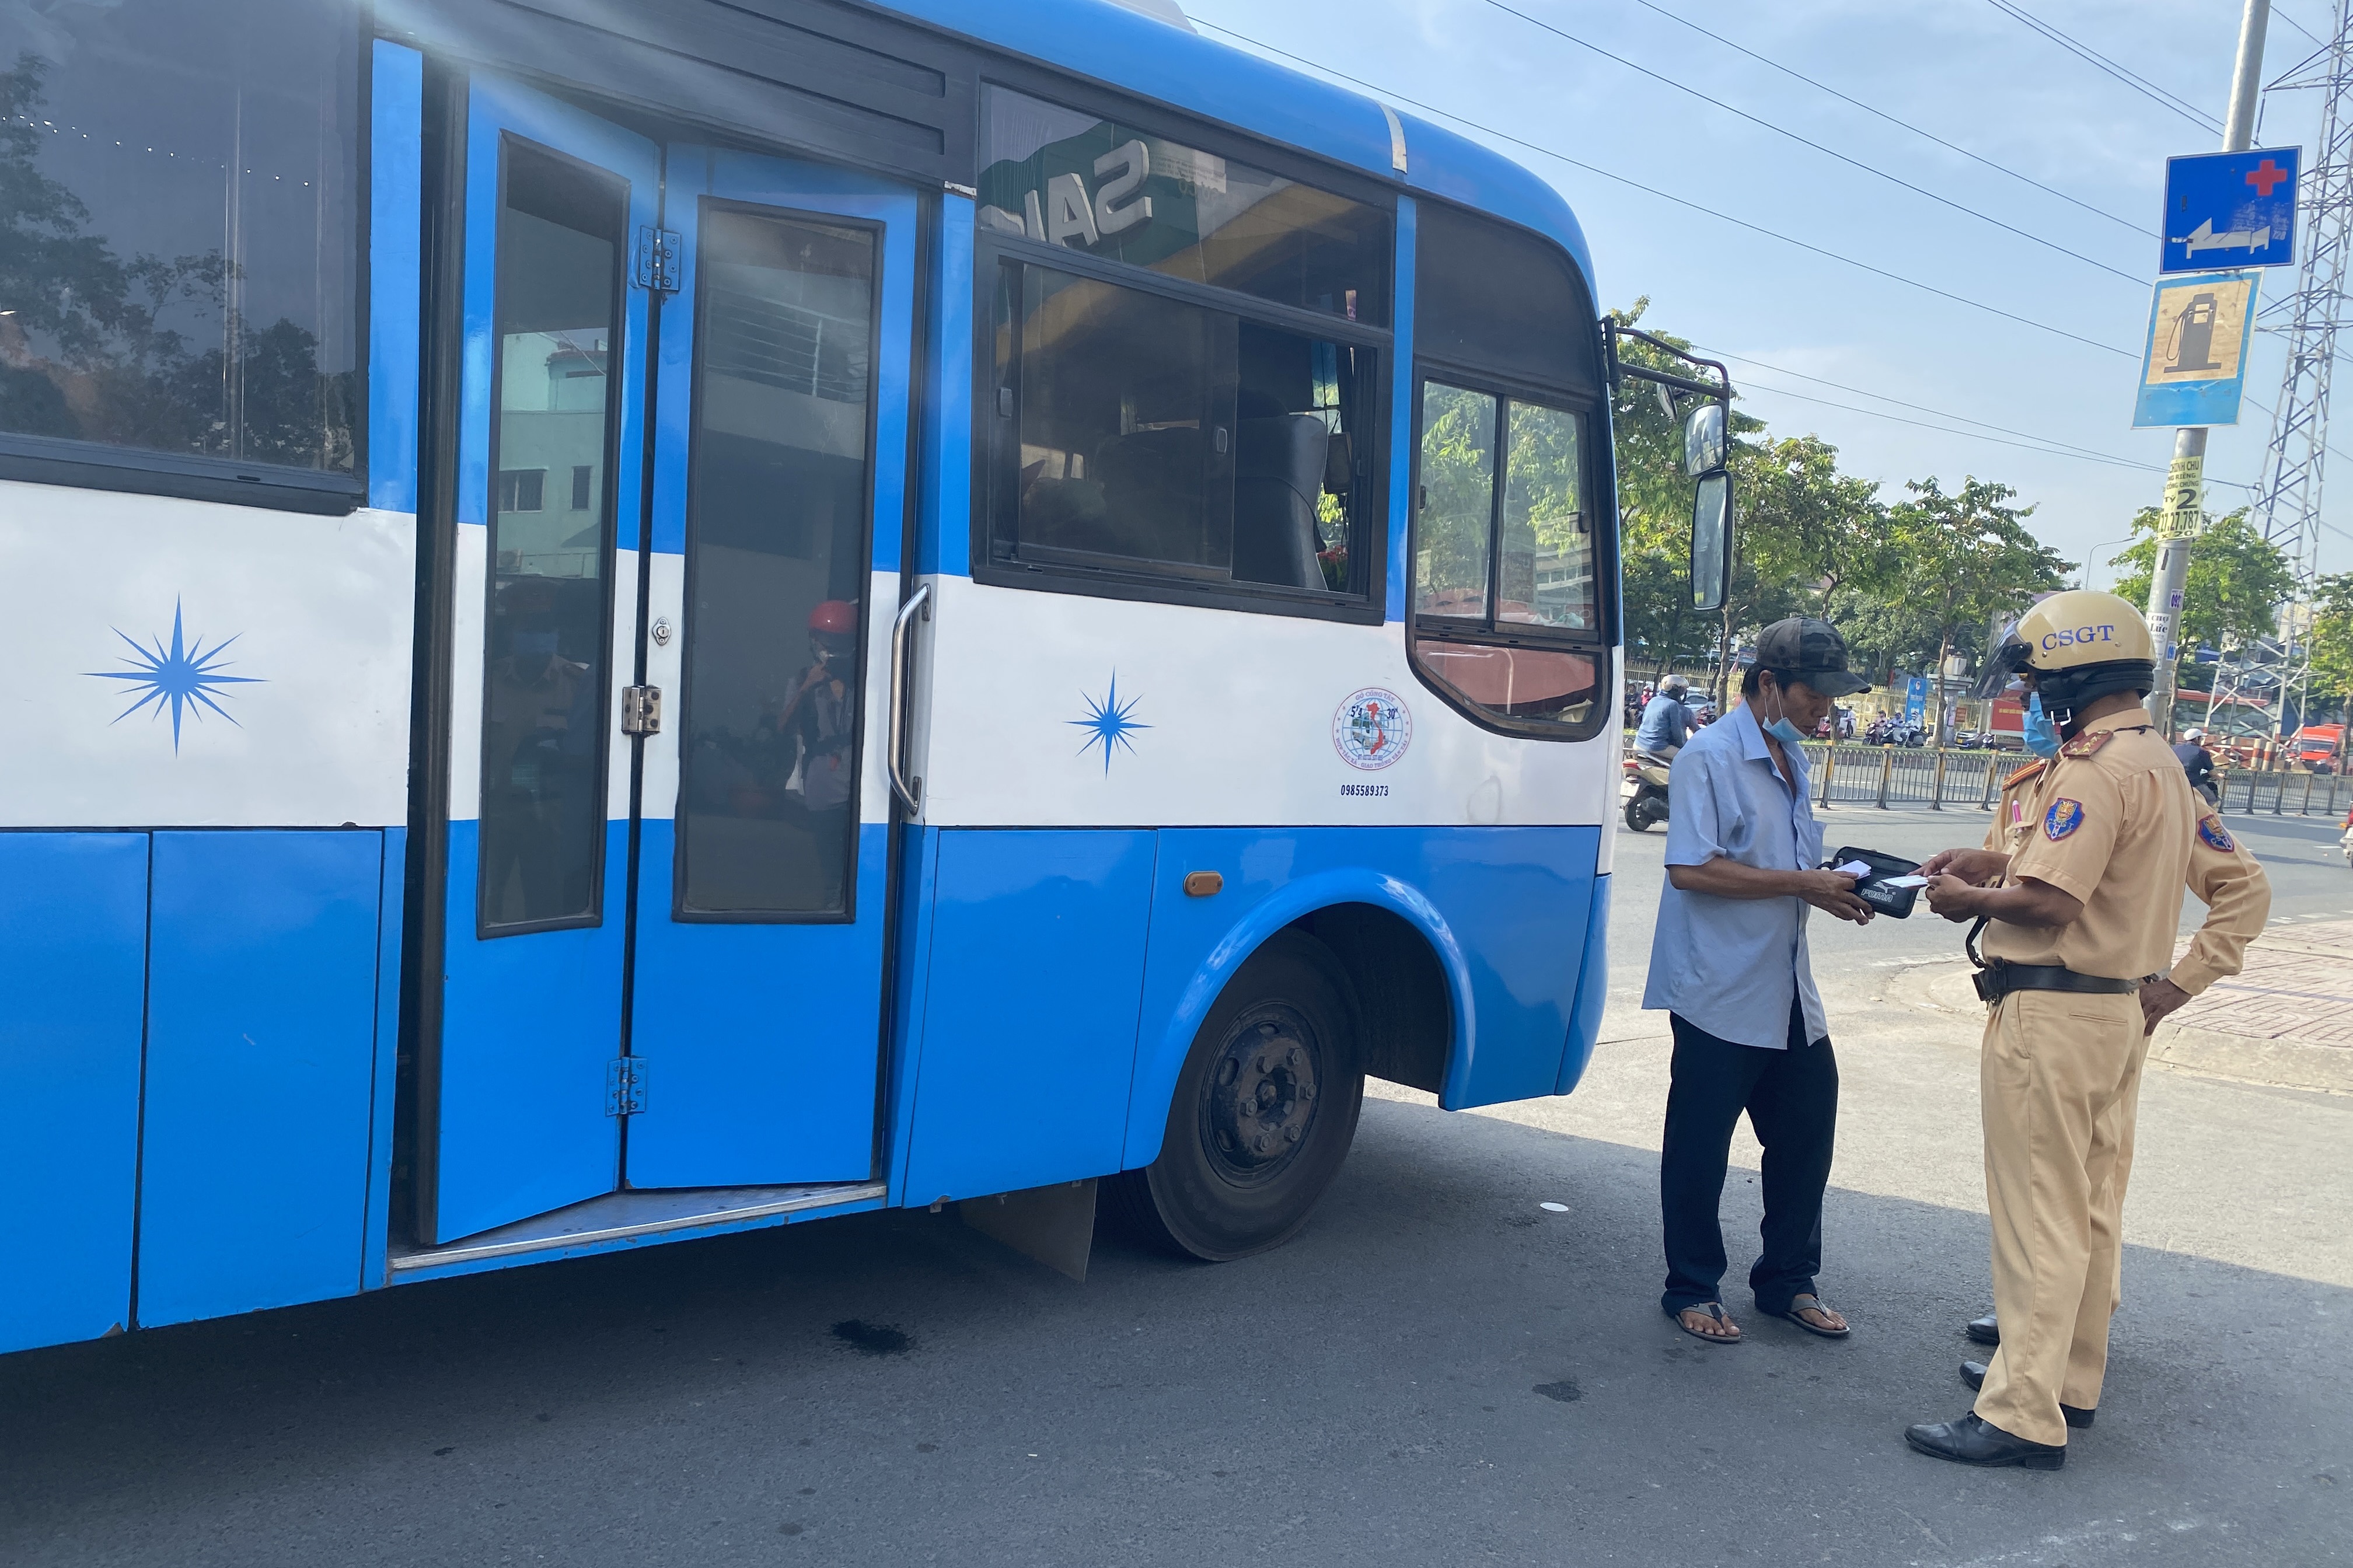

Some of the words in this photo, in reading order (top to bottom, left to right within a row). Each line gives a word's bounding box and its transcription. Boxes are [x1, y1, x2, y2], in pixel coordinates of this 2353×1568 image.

[2177, 489, 2198, 509] 2
[2043, 625, 2114, 650] CSGT
[1374, 759, 1392, 768] THÔNG
[1341, 785, 1388, 796] 0985589373
[1861, 888, 1894, 903] PUMA
